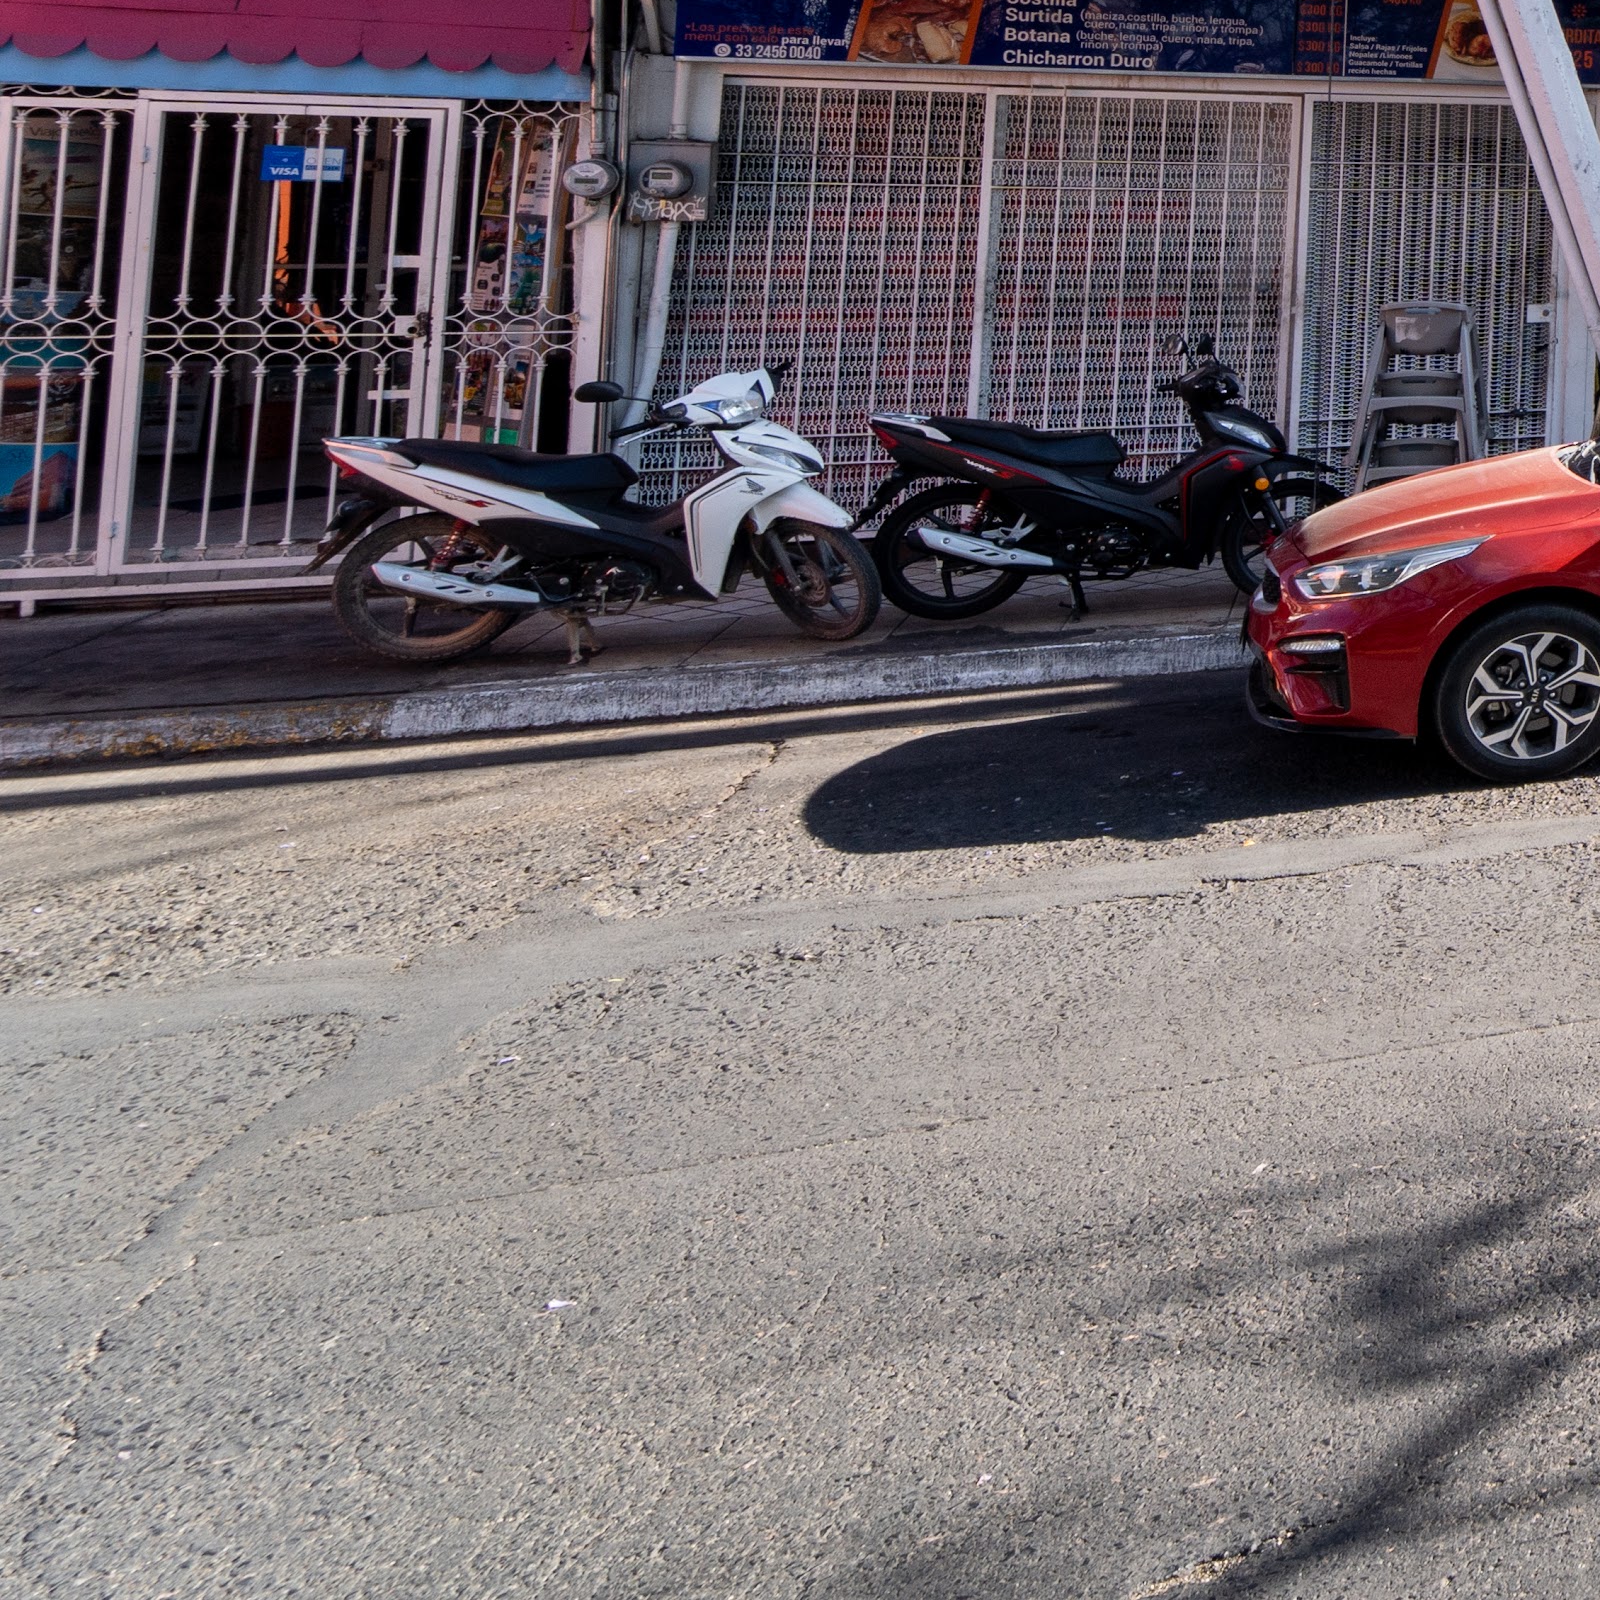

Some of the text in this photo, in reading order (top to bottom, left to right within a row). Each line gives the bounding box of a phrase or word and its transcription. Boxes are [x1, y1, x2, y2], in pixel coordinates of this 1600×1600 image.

[1005, 7, 1073, 24] Surtida
[781, 35, 848, 47] para llevar
[1004, 27, 1070, 43] Botana
[735, 43, 821, 60] 33 2456 0040
[1110, 53, 1154, 68] Duro
[307, 157, 340, 165] OEN
[269, 167, 299, 176] VISA
